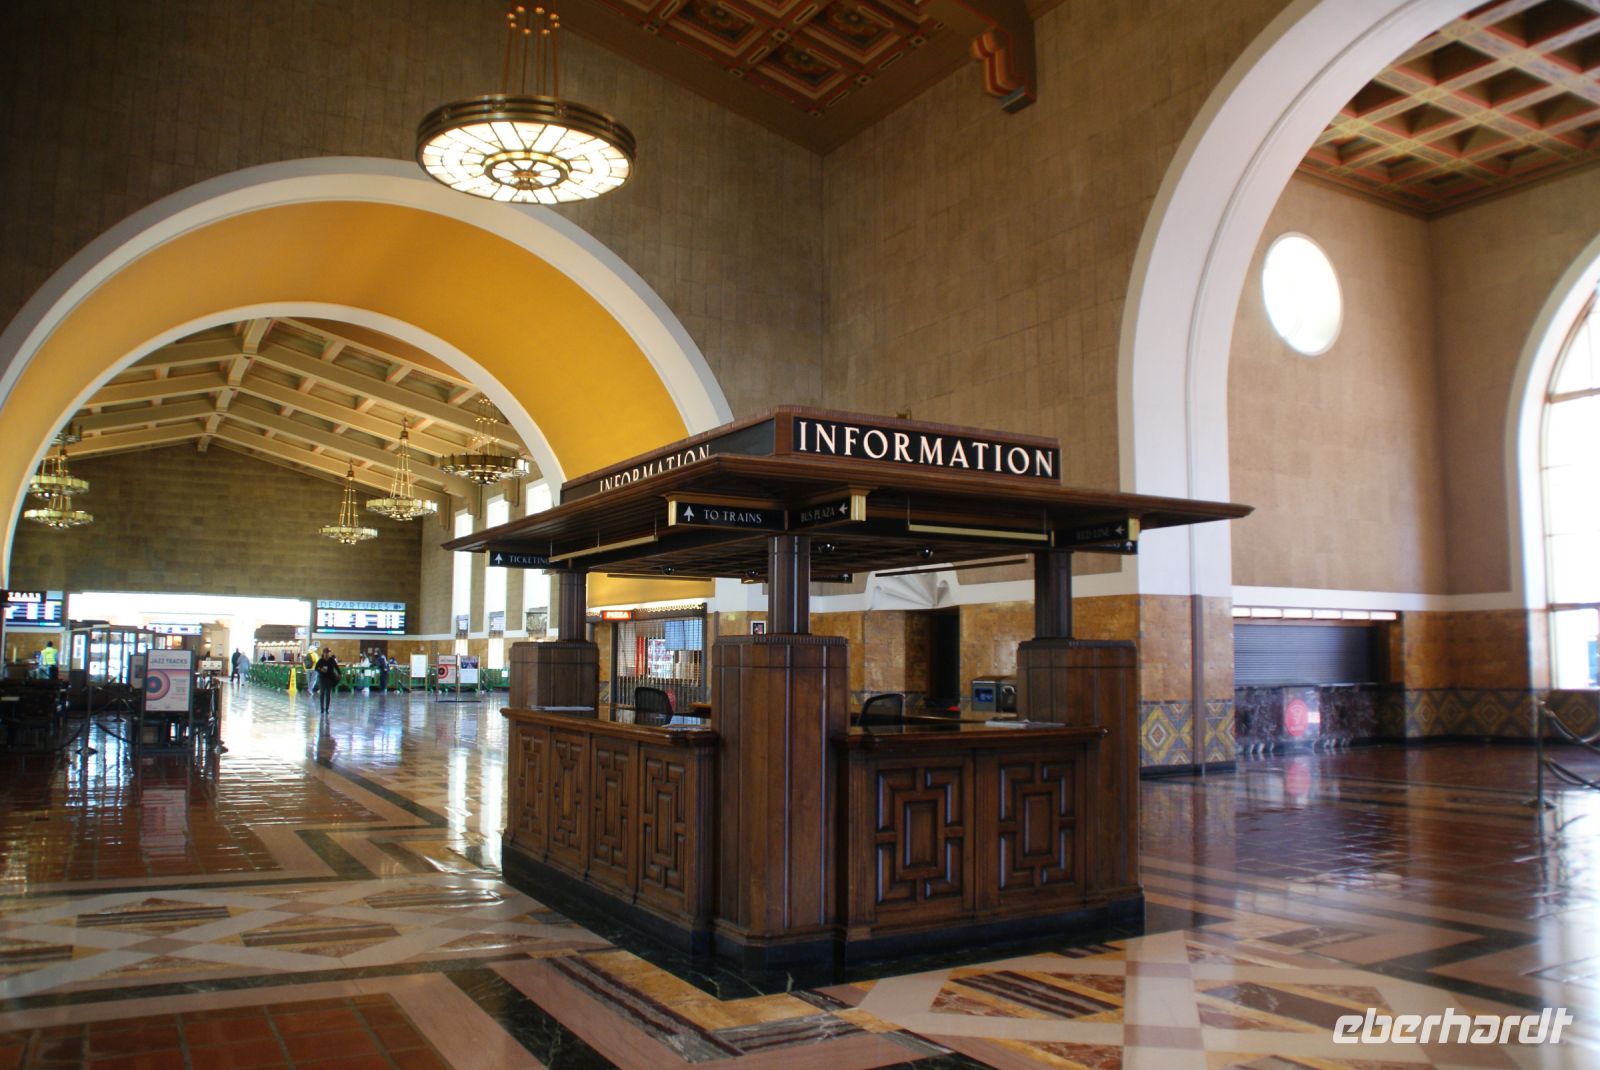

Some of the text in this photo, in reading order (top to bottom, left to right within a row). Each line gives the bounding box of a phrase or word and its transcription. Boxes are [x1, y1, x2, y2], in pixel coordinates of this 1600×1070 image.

[799, 421, 1054, 478] INFORMATION
[599, 444, 710, 492] INFORMATION
[704, 509, 762, 524] TO TRAINS
[800, 507, 835, 523] BUS PLAZA
[320, 601, 391, 610] DEPARTURES
